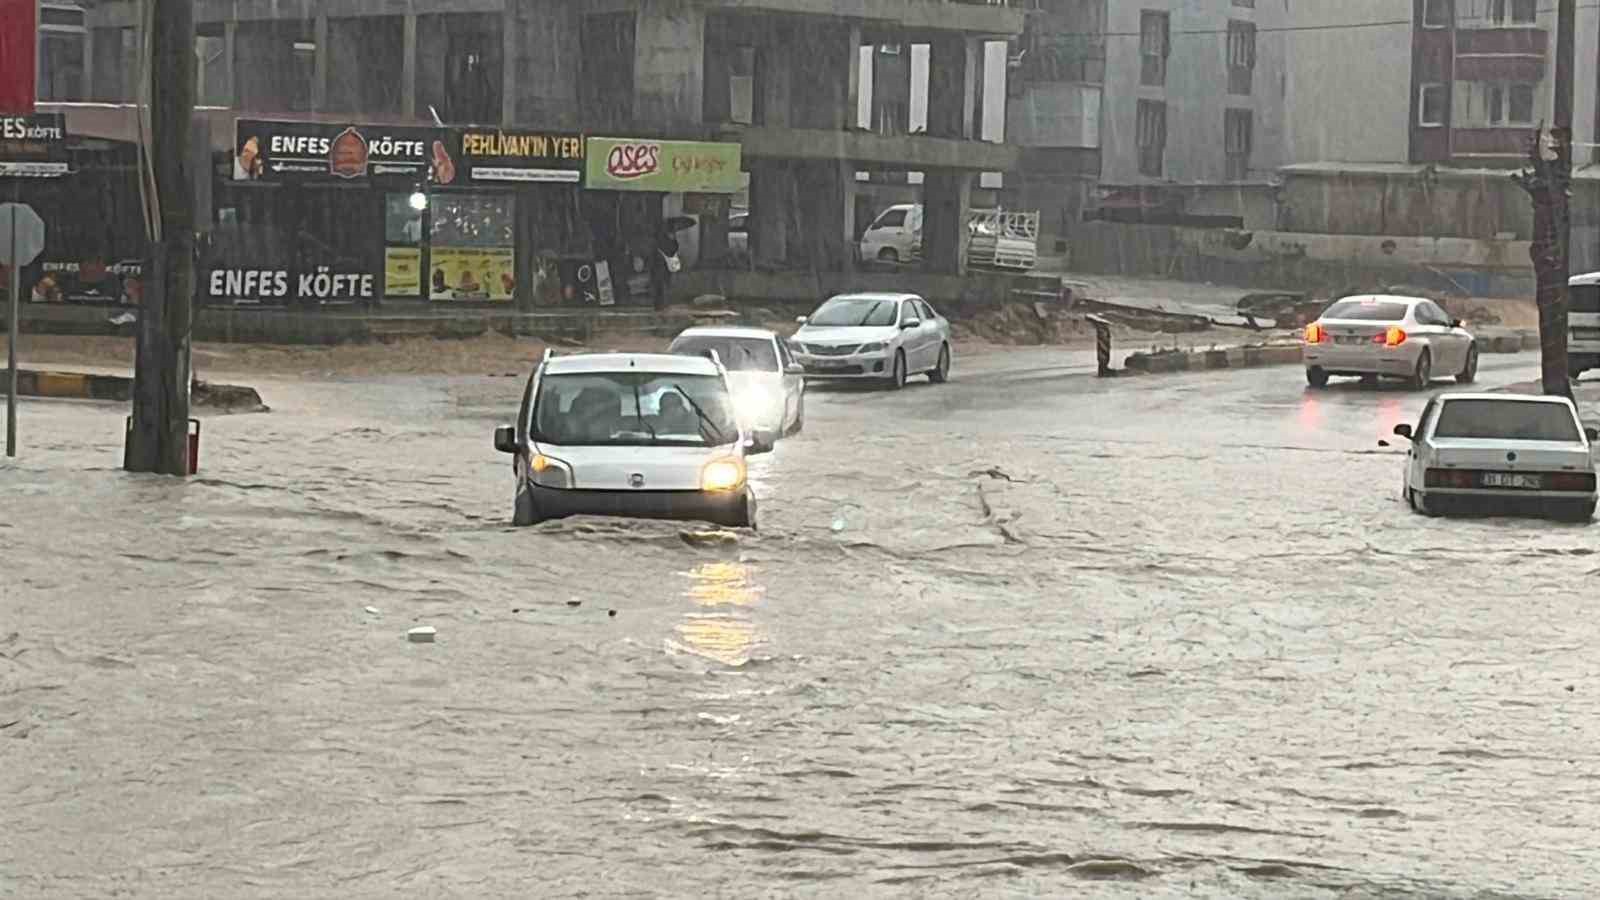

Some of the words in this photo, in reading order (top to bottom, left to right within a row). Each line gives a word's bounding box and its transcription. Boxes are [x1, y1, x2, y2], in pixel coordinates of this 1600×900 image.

[271, 136, 330, 154] ENFES
[368, 136, 424, 155] KÖFTE
[550, 133, 584, 159] YERİ
[209, 269, 288, 296] ENFES
[298, 265, 374, 297] KÖFTE
